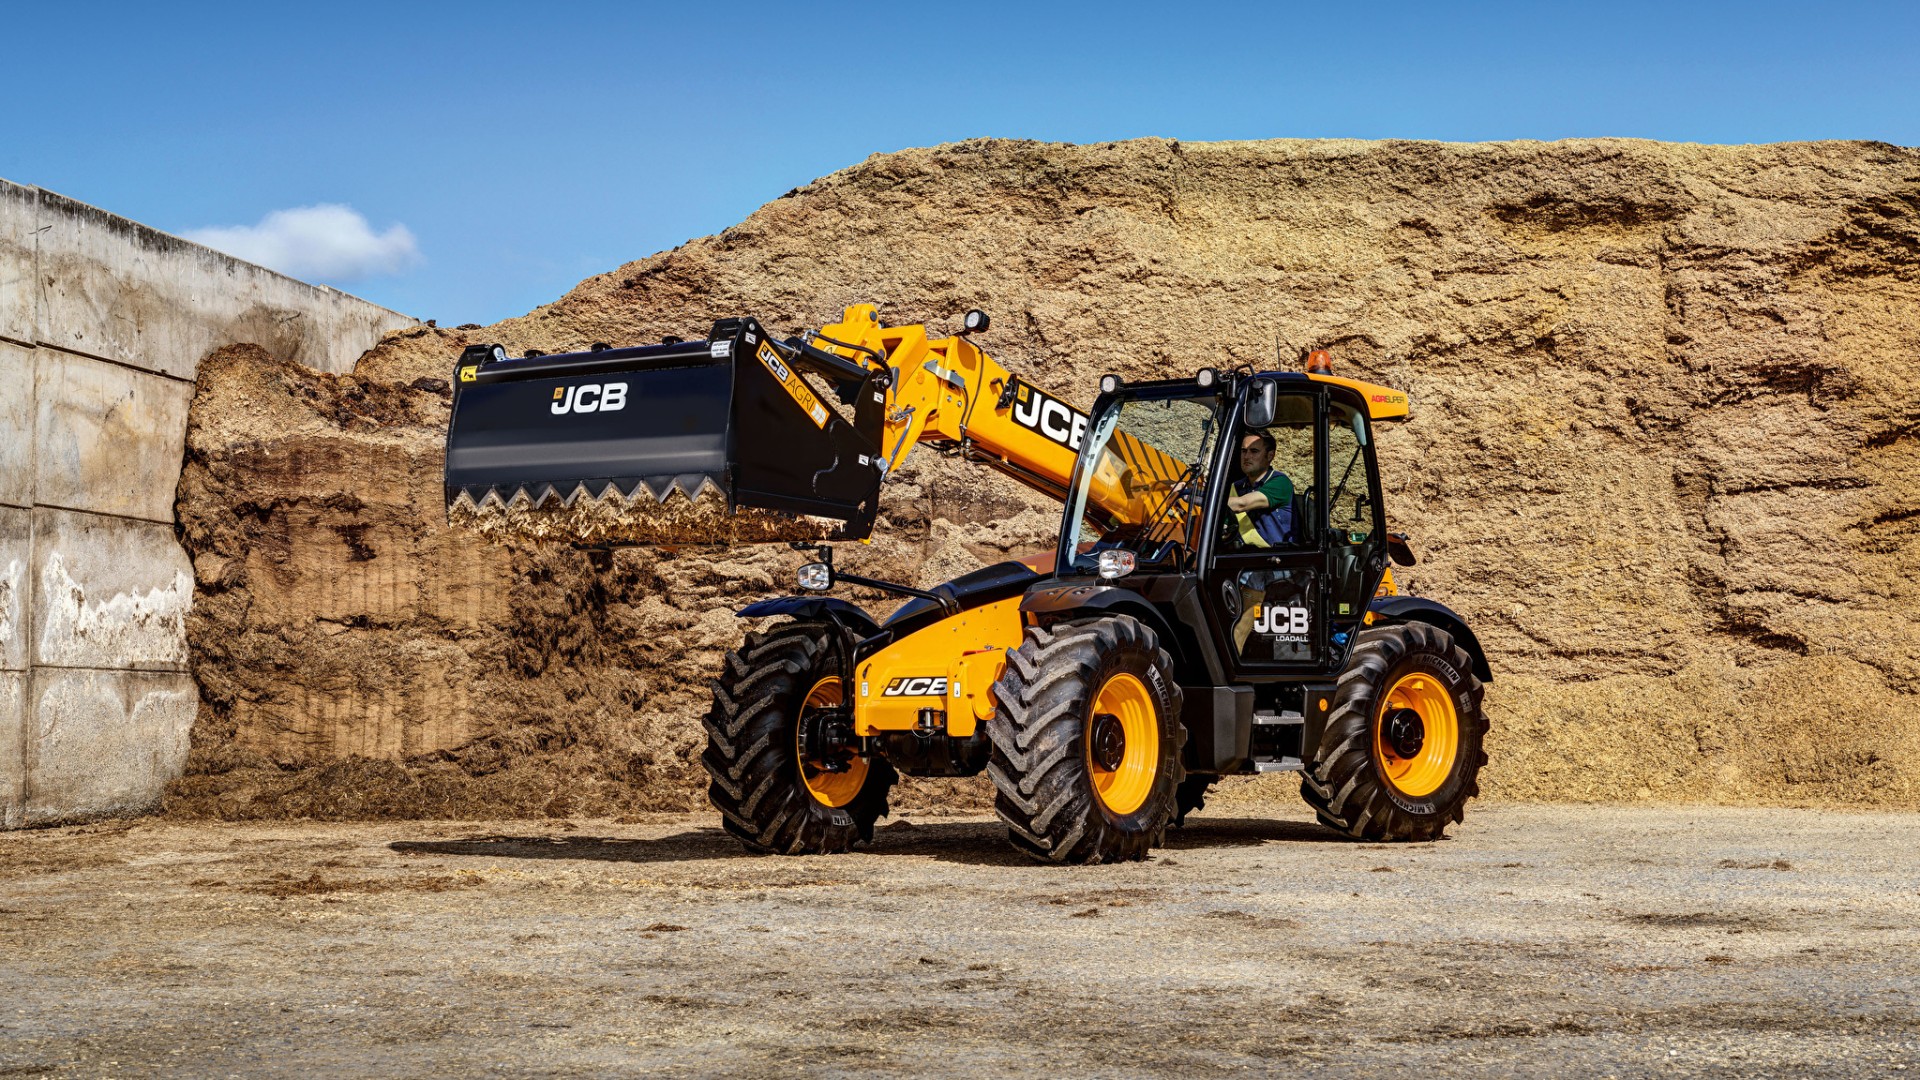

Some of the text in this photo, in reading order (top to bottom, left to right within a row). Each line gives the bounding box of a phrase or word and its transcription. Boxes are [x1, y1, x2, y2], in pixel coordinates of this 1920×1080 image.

[760, 349, 816, 412] JCB AGRI
[551, 382, 628, 415] JCB
[1253, 606, 1309, 634] JCB
[1421, 654, 1460, 684] MICHELIN
[884, 677, 948, 696] JCB
